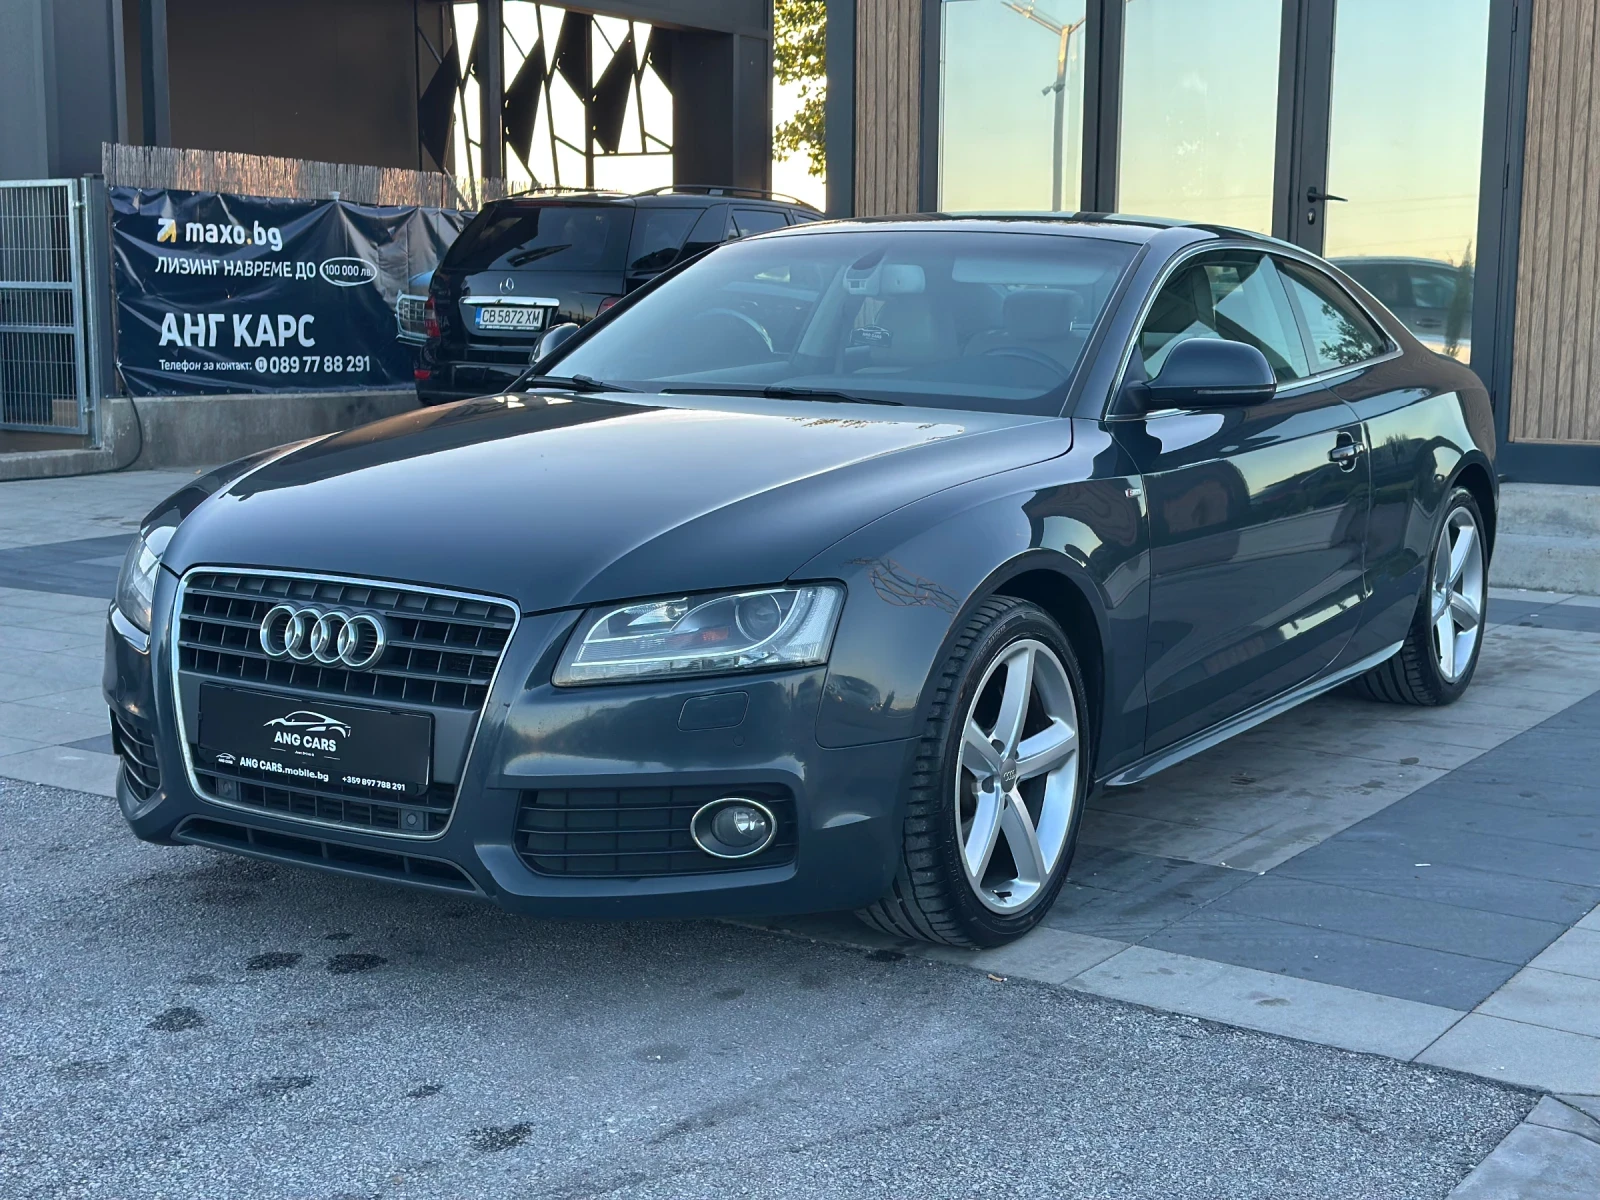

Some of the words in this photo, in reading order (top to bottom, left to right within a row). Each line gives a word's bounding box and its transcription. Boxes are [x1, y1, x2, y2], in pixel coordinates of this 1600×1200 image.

[186, 221, 282, 251] maxo.bg
[155, 257, 220, 276] ЛИЗИНГ
[224, 261, 292, 277] НАВРЕМЕ
[296, 261, 316, 279] ДО
[325, 265, 340, 275] 100
[341, 265, 359, 276] 000
[482, 310, 495, 322] CB
[498, 311, 523, 323] 5872
[525, 311, 540, 324] XM
[159, 313, 225, 346] АНГ
[234, 314, 315, 347] КАРС
[159, 359, 201, 372] Телефон
[203, 362, 214, 371] за
[216, 361, 252, 370] контакт:
[270, 357, 299, 372] 089
[303, 357, 320, 372] 77
[324, 356, 343, 372] 88
[346, 356, 370, 372] 291
[274, 731, 300, 746] ANG
[303, 733, 336, 751] CARS
[240, 757, 258, 769] ANG
[342, 776, 360, 785] +359
[361, 779, 375, 787] 897
[376, 781, 391, 789] 788
[392, 782, 405, 791] 291
